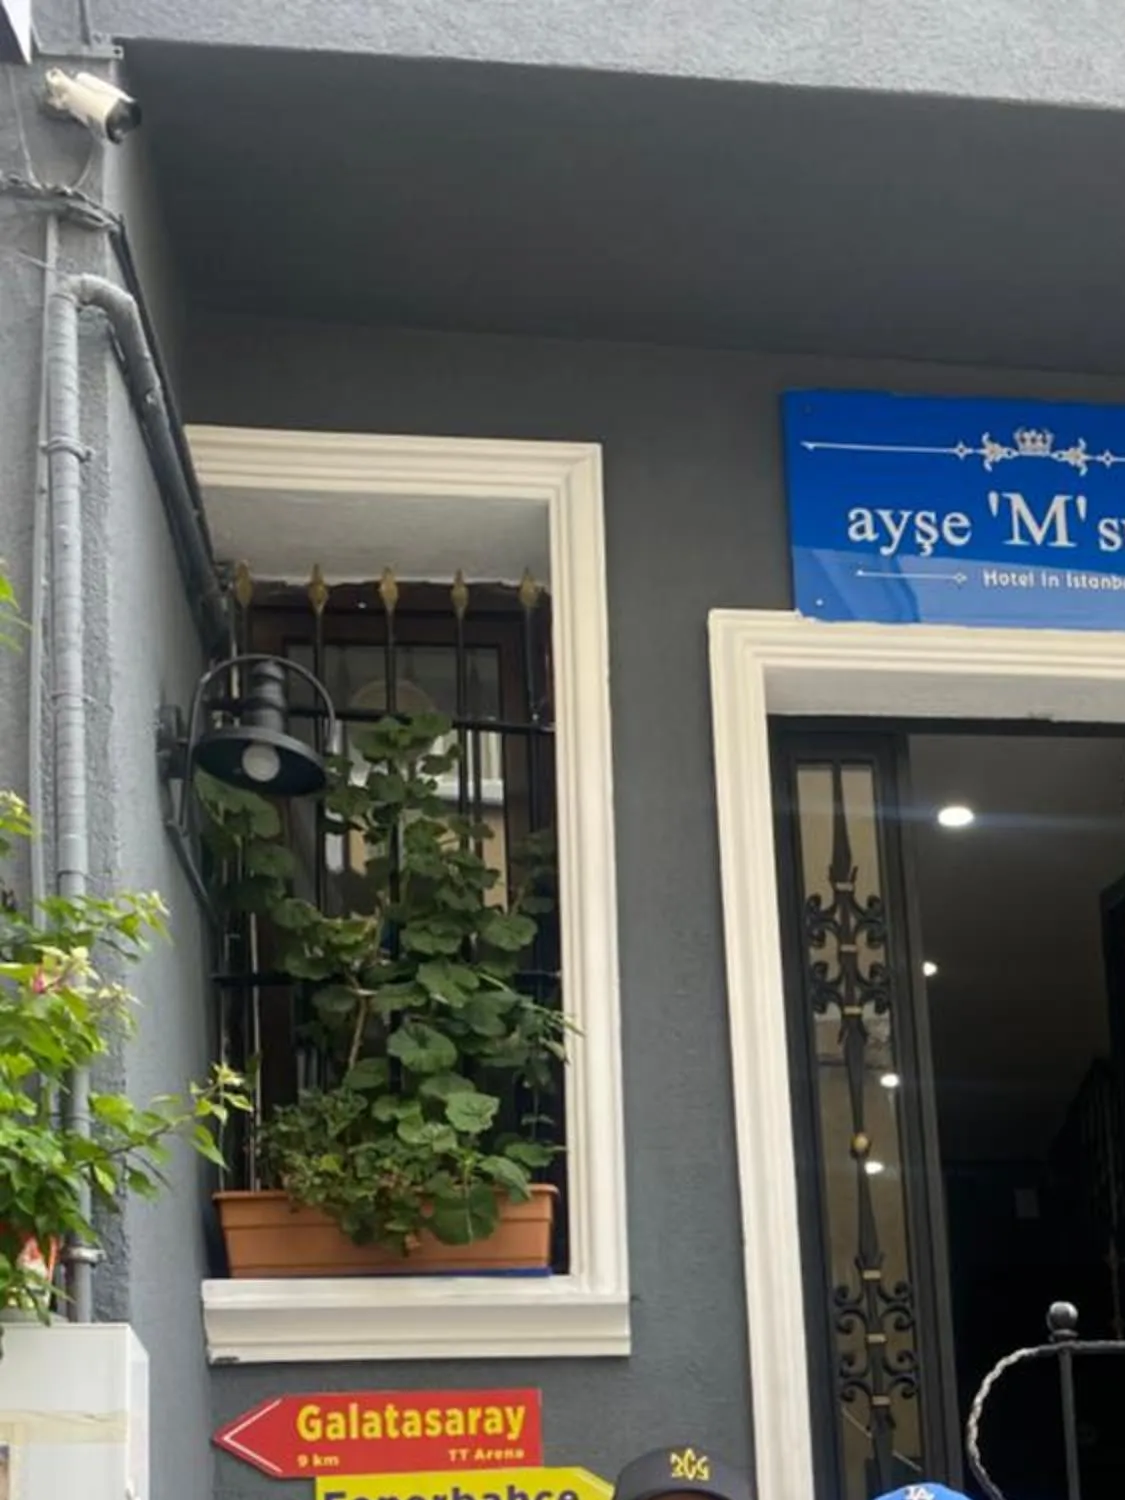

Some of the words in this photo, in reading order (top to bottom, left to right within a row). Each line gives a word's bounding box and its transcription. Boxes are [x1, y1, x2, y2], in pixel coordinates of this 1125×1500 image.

[848, 505, 971, 556] ayşe
[983, 569, 1034, 588] Hotel
[297, 1402, 525, 1441] Galatasaray
[313, 1454, 339, 1467] km
[449, 1449, 469, 1462] TT
[474, 1447, 524, 1460] Arena
